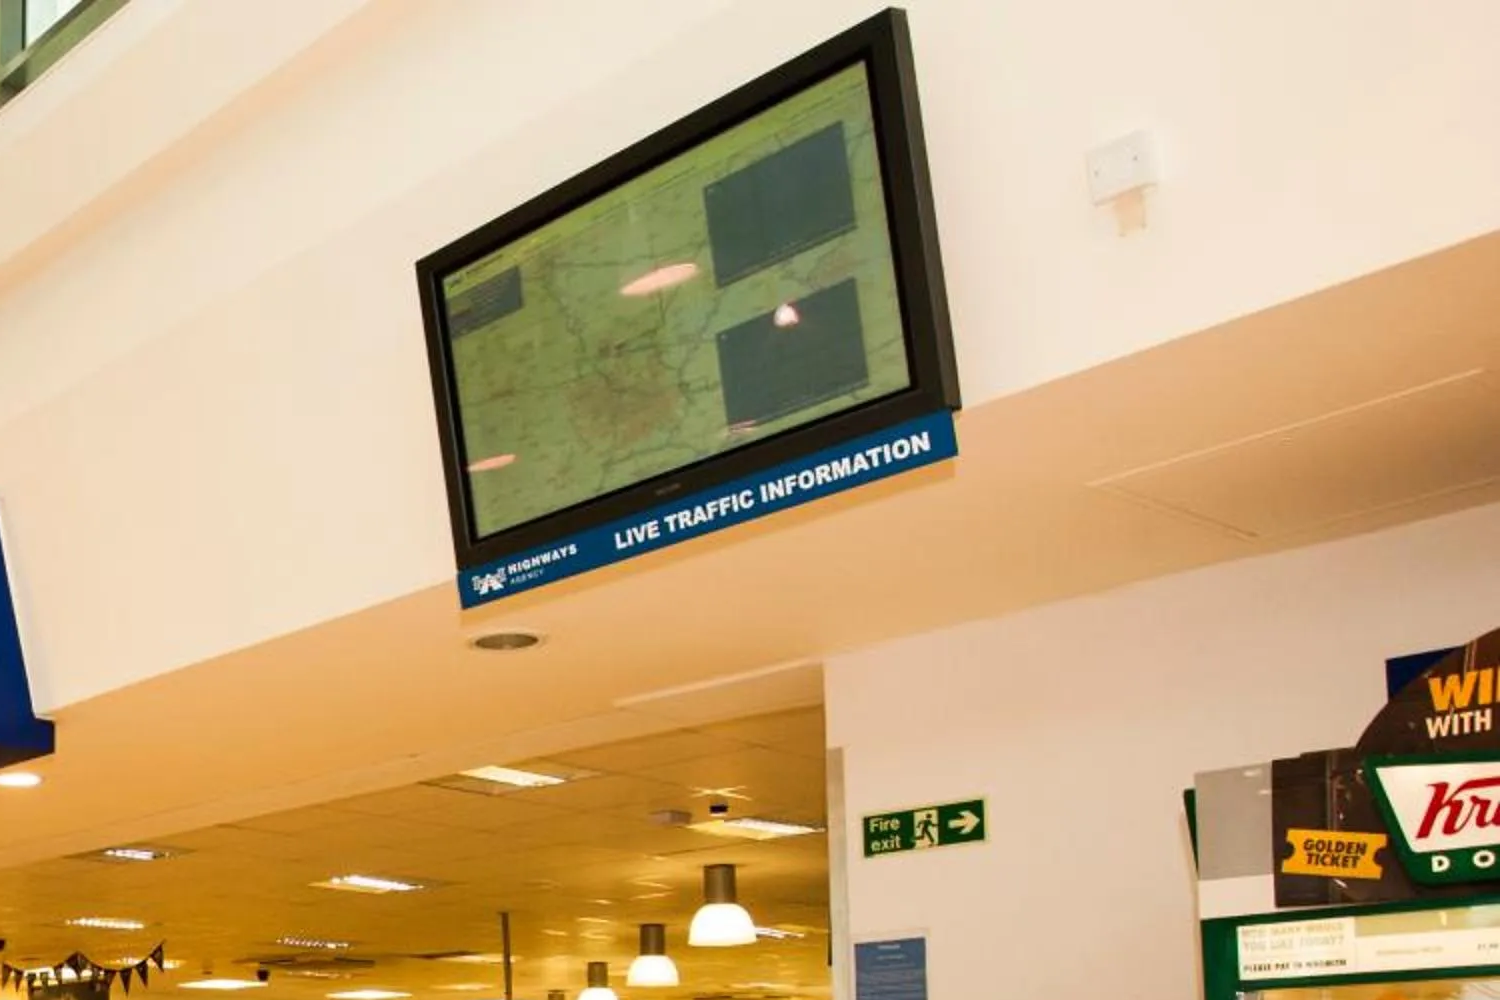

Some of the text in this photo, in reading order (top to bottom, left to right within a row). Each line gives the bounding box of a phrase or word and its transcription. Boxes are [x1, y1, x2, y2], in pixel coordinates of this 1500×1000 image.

[613, 431, 931, 551] LIVE TRAFFIC INFORMATION
[508, 543, 578, 575] HIGHWAYS
[1428, 665, 1500, 712] WI
[1426, 708, 1492, 739] WITH
[869, 817, 901, 833] Fire
[870, 835, 901, 852] exit
[1303, 838, 1367, 855] GOLDEN
[1306, 852, 1361, 869] TICKET
[1274, 961, 1290, 971] PAY
